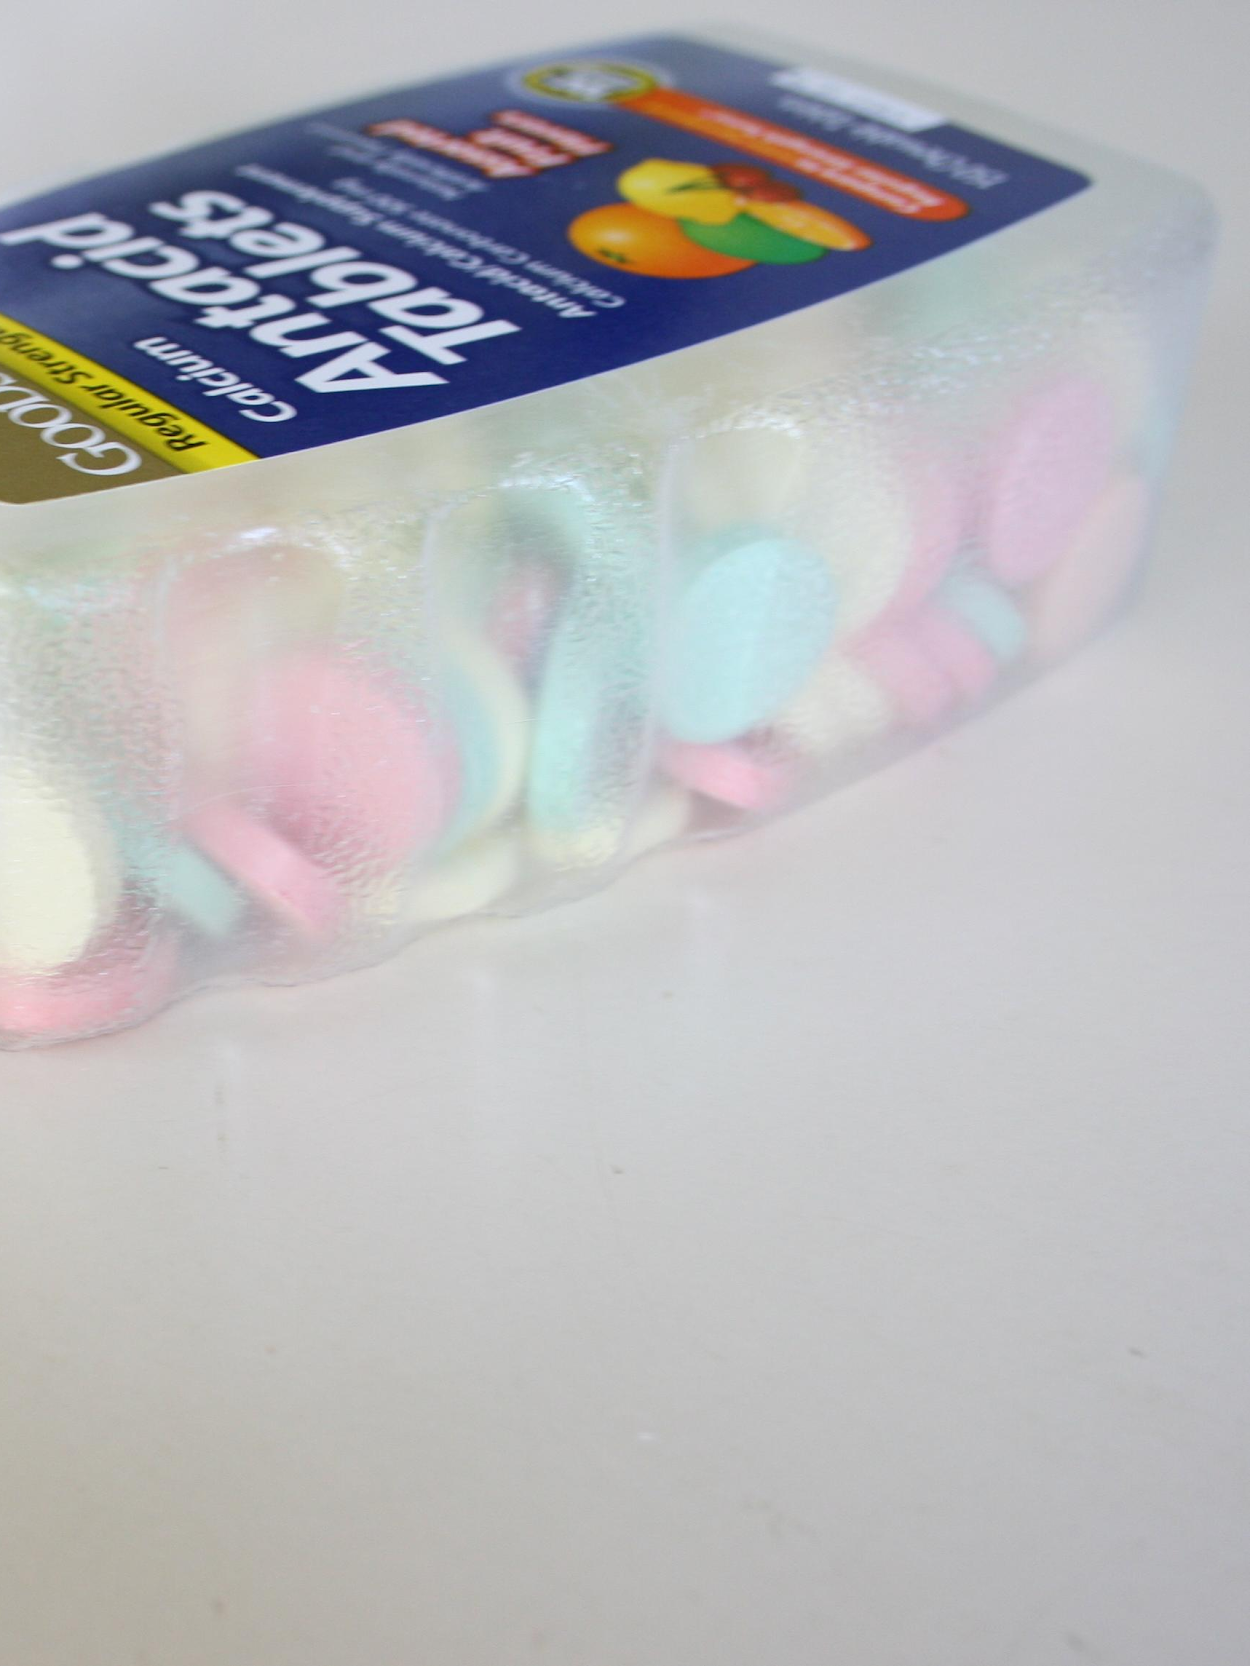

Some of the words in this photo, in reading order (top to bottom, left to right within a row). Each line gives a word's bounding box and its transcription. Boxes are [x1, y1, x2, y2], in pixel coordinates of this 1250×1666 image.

[151, 191, 519, 364] Tablets
[525, 260, 624, 307] Calcium
[134, 336, 296, 422] Calcium
[79, 384, 207, 451] Regular
